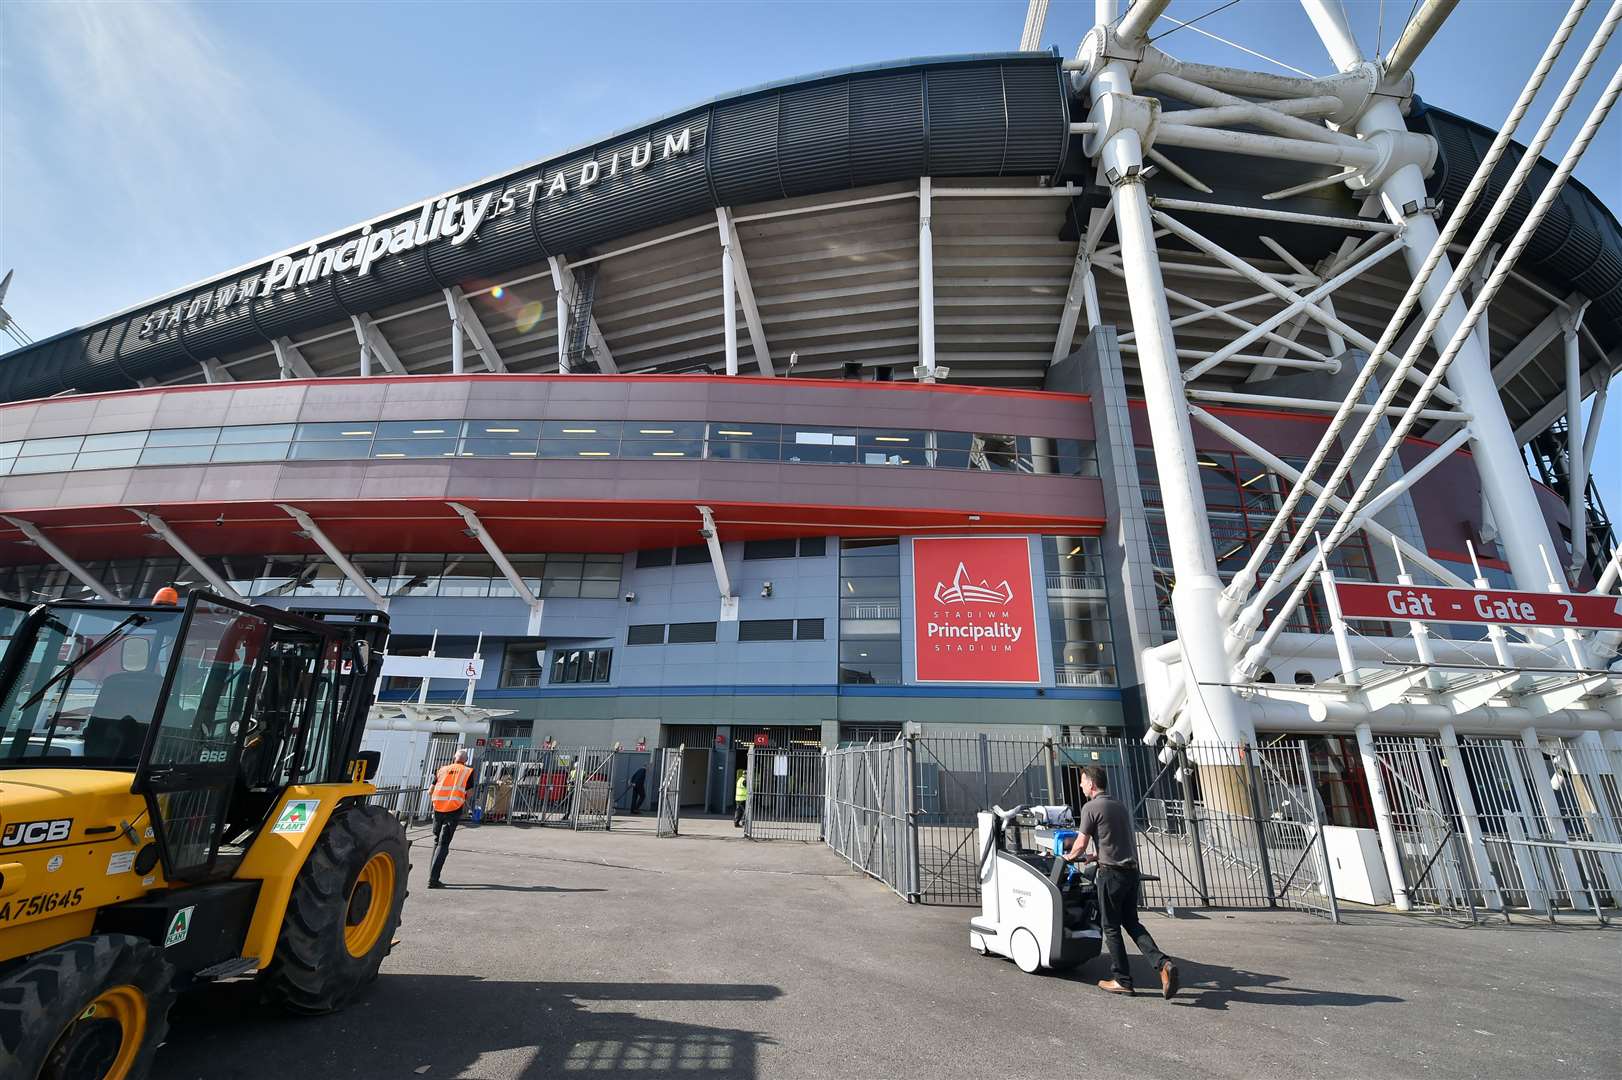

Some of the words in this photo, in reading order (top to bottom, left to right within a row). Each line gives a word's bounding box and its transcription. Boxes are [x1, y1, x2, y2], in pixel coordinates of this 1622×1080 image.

[139, 275, 261, 335] STADIWM
[258, 191, 493, 298] Principality
[498, 128, 692, 214] STADIUM
[933, 611, 1009, 619] STADIWM
[1387, 590, 1436, 616] Gât
[1474, 594, 1537, 621] Gate
[1557, 599, 1578, 623] 2
[927, 622, 1022, 642] Principality
[935, 644, 1012, 652] STADIUM
[2, 820, 71, 847] JCB
[273, 823, 306, 831] PLANT
